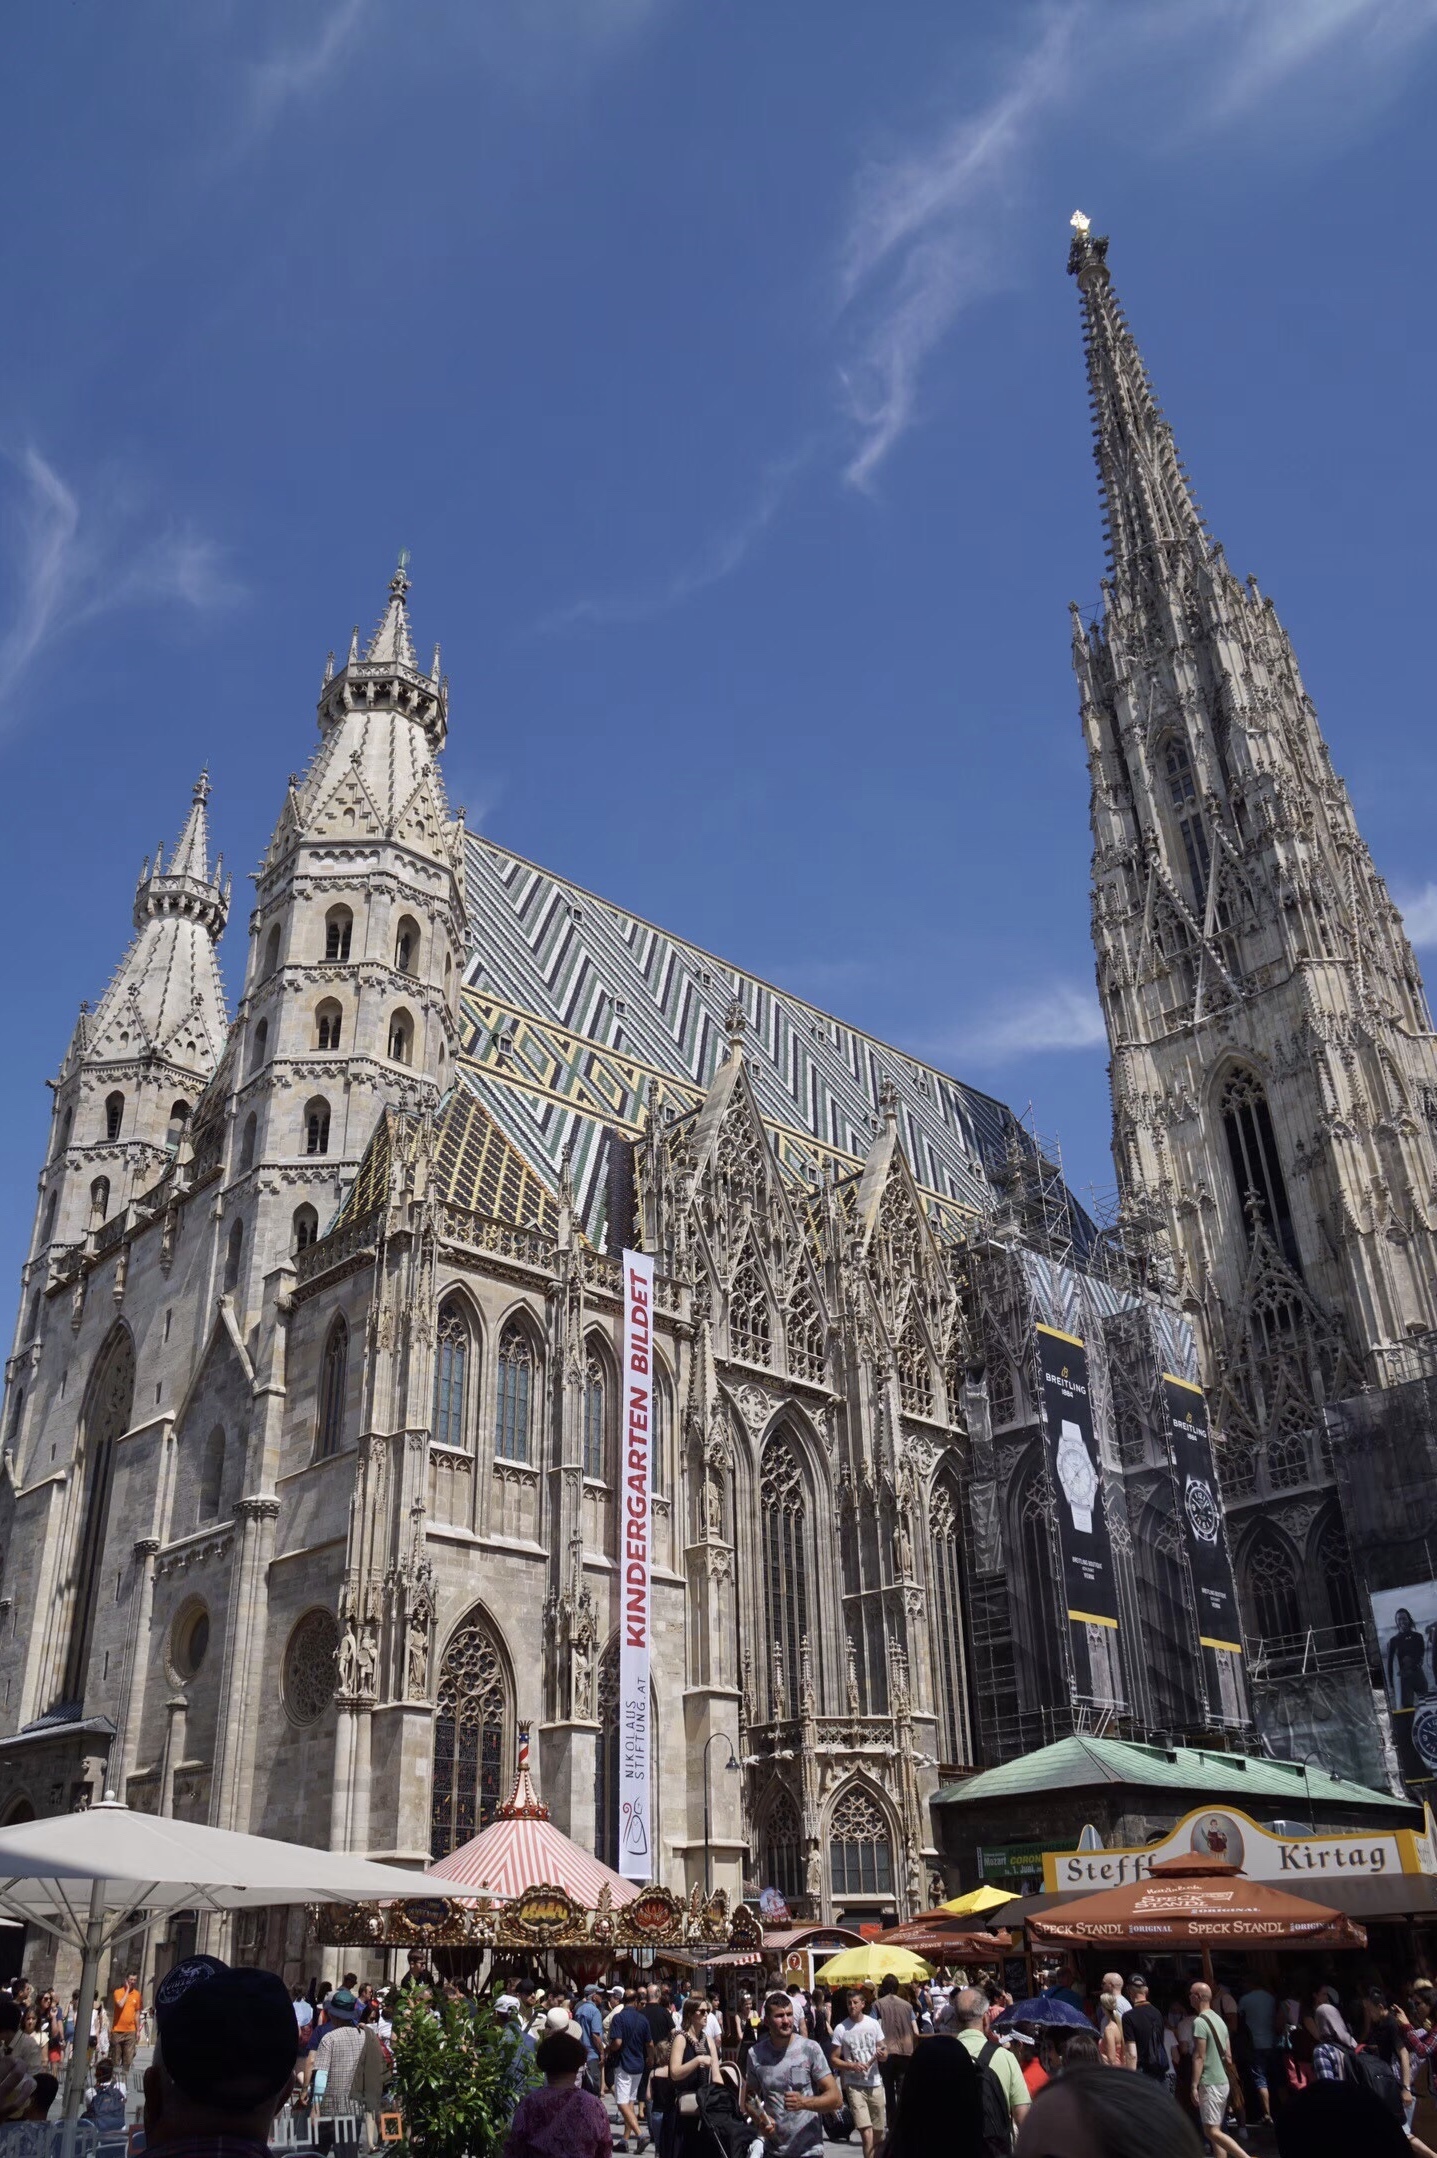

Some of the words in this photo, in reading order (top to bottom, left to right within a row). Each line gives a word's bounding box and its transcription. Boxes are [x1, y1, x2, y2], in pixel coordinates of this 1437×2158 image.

[630, 1267, 648, 1376] BILDET
[1045, 1372, 1087, 1395] BREITLING
[1172, 1418, 1207, 1439] BREITLING
[627, 1385, 648, 1649] KINDERGARTEN
[625, 1700, 636, 1778] NIKOLAUS
[635, 1677, 646, 1780] STIFTUNG.AT
[1278, 1844, 1386, 1873] Kirtag
[1134, 1900, 1209, 1909] STANDL
[1140, 1894, 1204, 1902] SPECK
[1034, 1921, 1074, 1935] SPECK
[1075, 1921, 1124, 1935] STANDL
[1133, 1924, 1173, 1933] ORIGINAL
[1188, 1921, 1231, 1934] SPECK
[1232, 1920, 1285, 1934] STANDL
